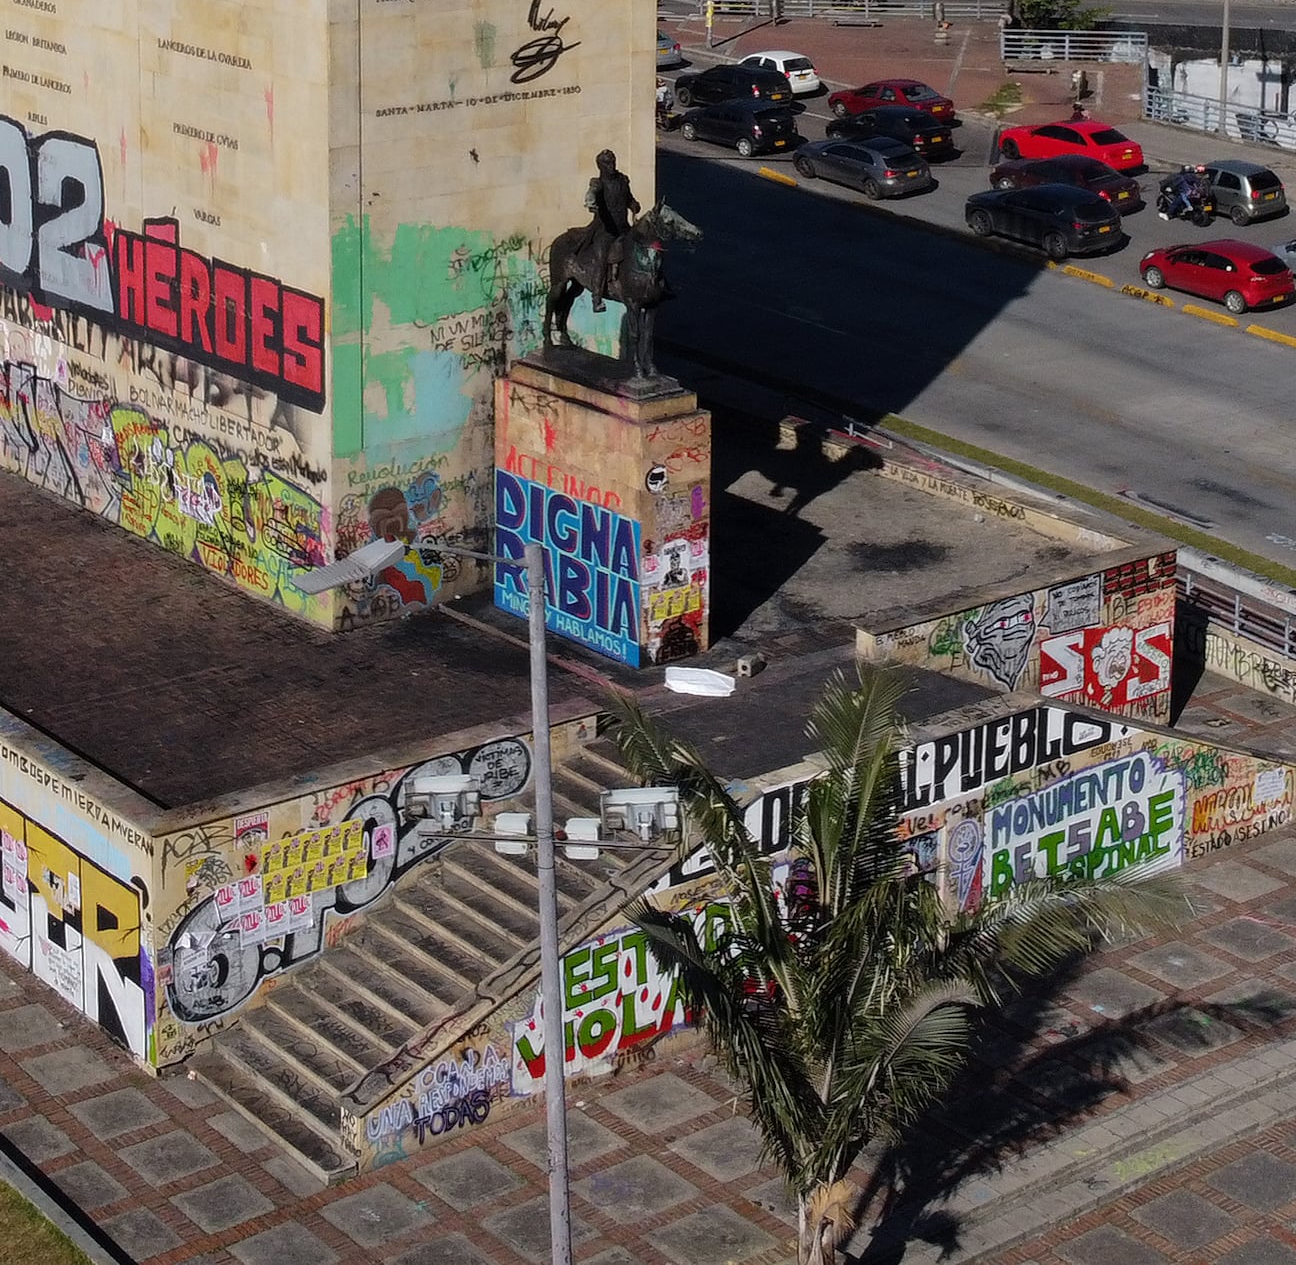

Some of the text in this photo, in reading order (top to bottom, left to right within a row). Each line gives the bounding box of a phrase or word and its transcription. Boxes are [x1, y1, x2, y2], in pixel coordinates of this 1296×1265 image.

[196, 46, 206, 59] DE
[207, 49, 217, 62] LA
[375, 107, 408, 118] SANTA
[416, 100, 454, 113] MARTA
[485, 96, 499, 106] DE
[503, 88, 556, 102] DICIEMBRE
[496, 469, 638, 581] DIGNA
[934, 707, 1112, 802] PUEBLO
[44, 775, 59, 794] DE
[61, 783, 111, 830] MIERDA
[991, 757, 1146, 850] MONUMENTO
[1191, 830, 1232, 859] ESTADO
[414, 1090, 491, 1146] TODAS
